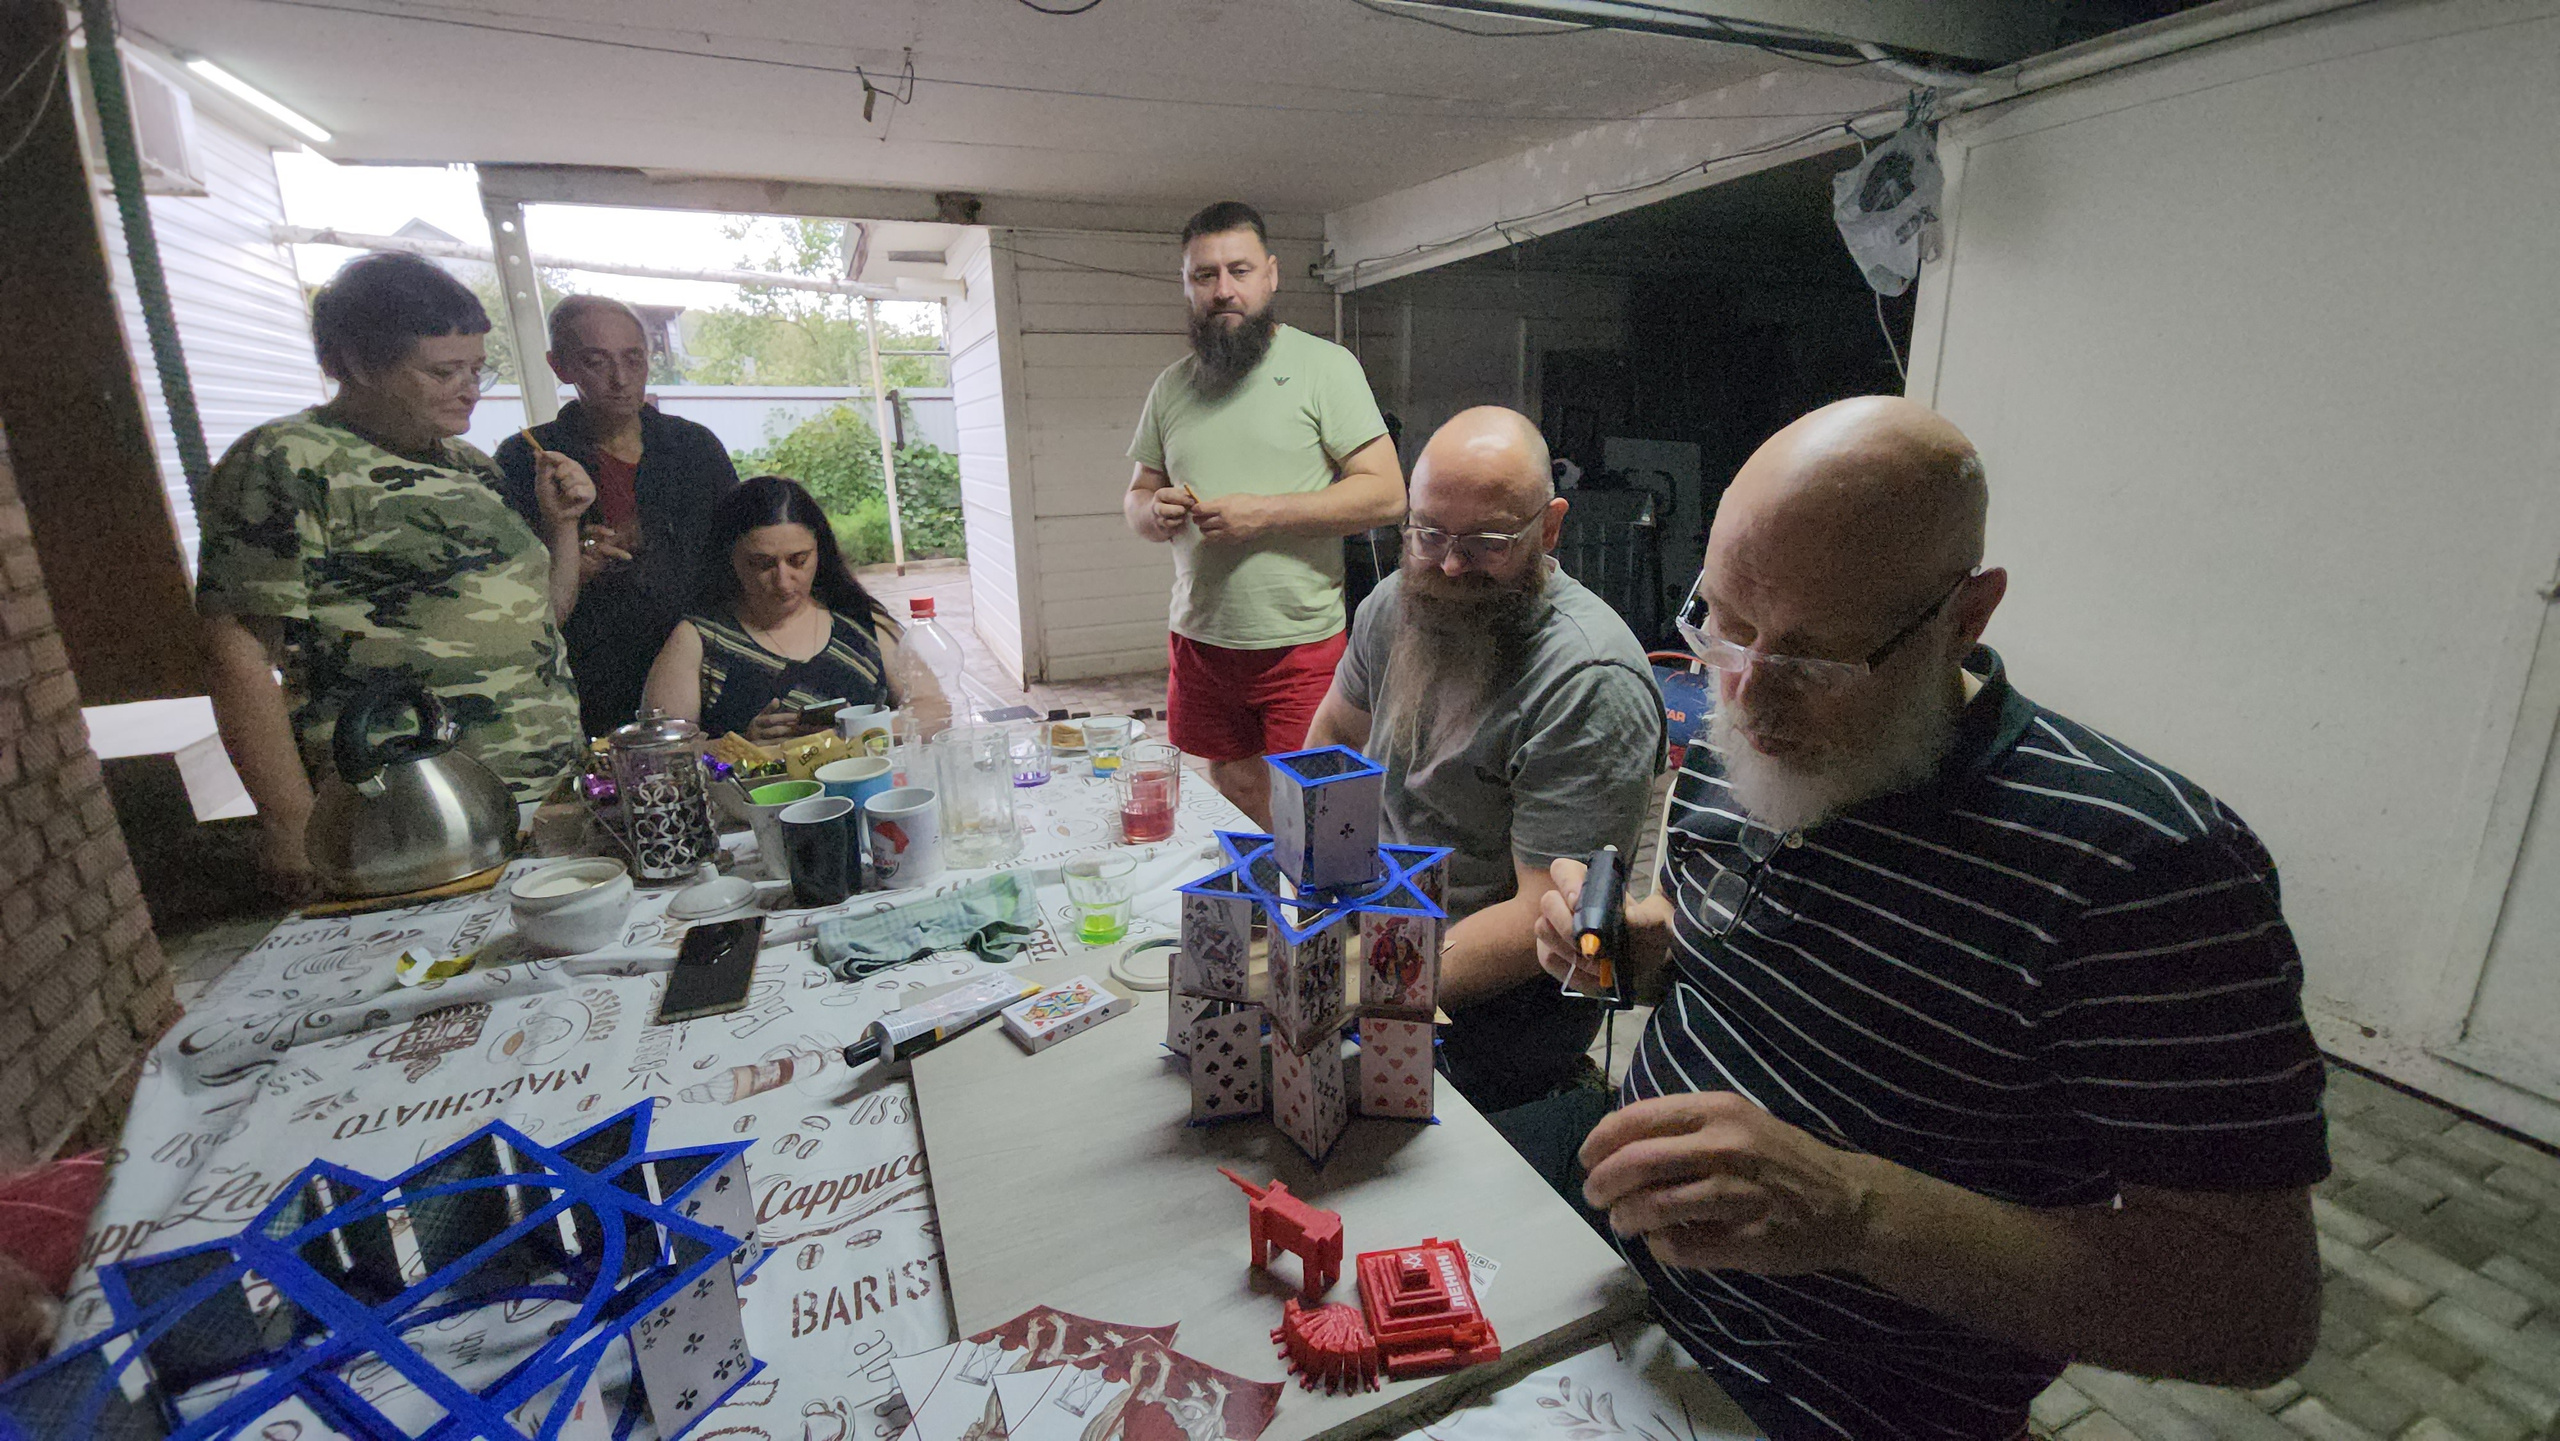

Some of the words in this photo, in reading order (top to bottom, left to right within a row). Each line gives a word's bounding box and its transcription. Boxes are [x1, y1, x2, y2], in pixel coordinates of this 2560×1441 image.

[256, 924, 351, 951] RISTA
[331, 1062, 593, 1141] MACCHIATO
[756, 1152, 931, 1223] Cappucc
[1435, 1254, 1467, 1308] ЛЕНИН
